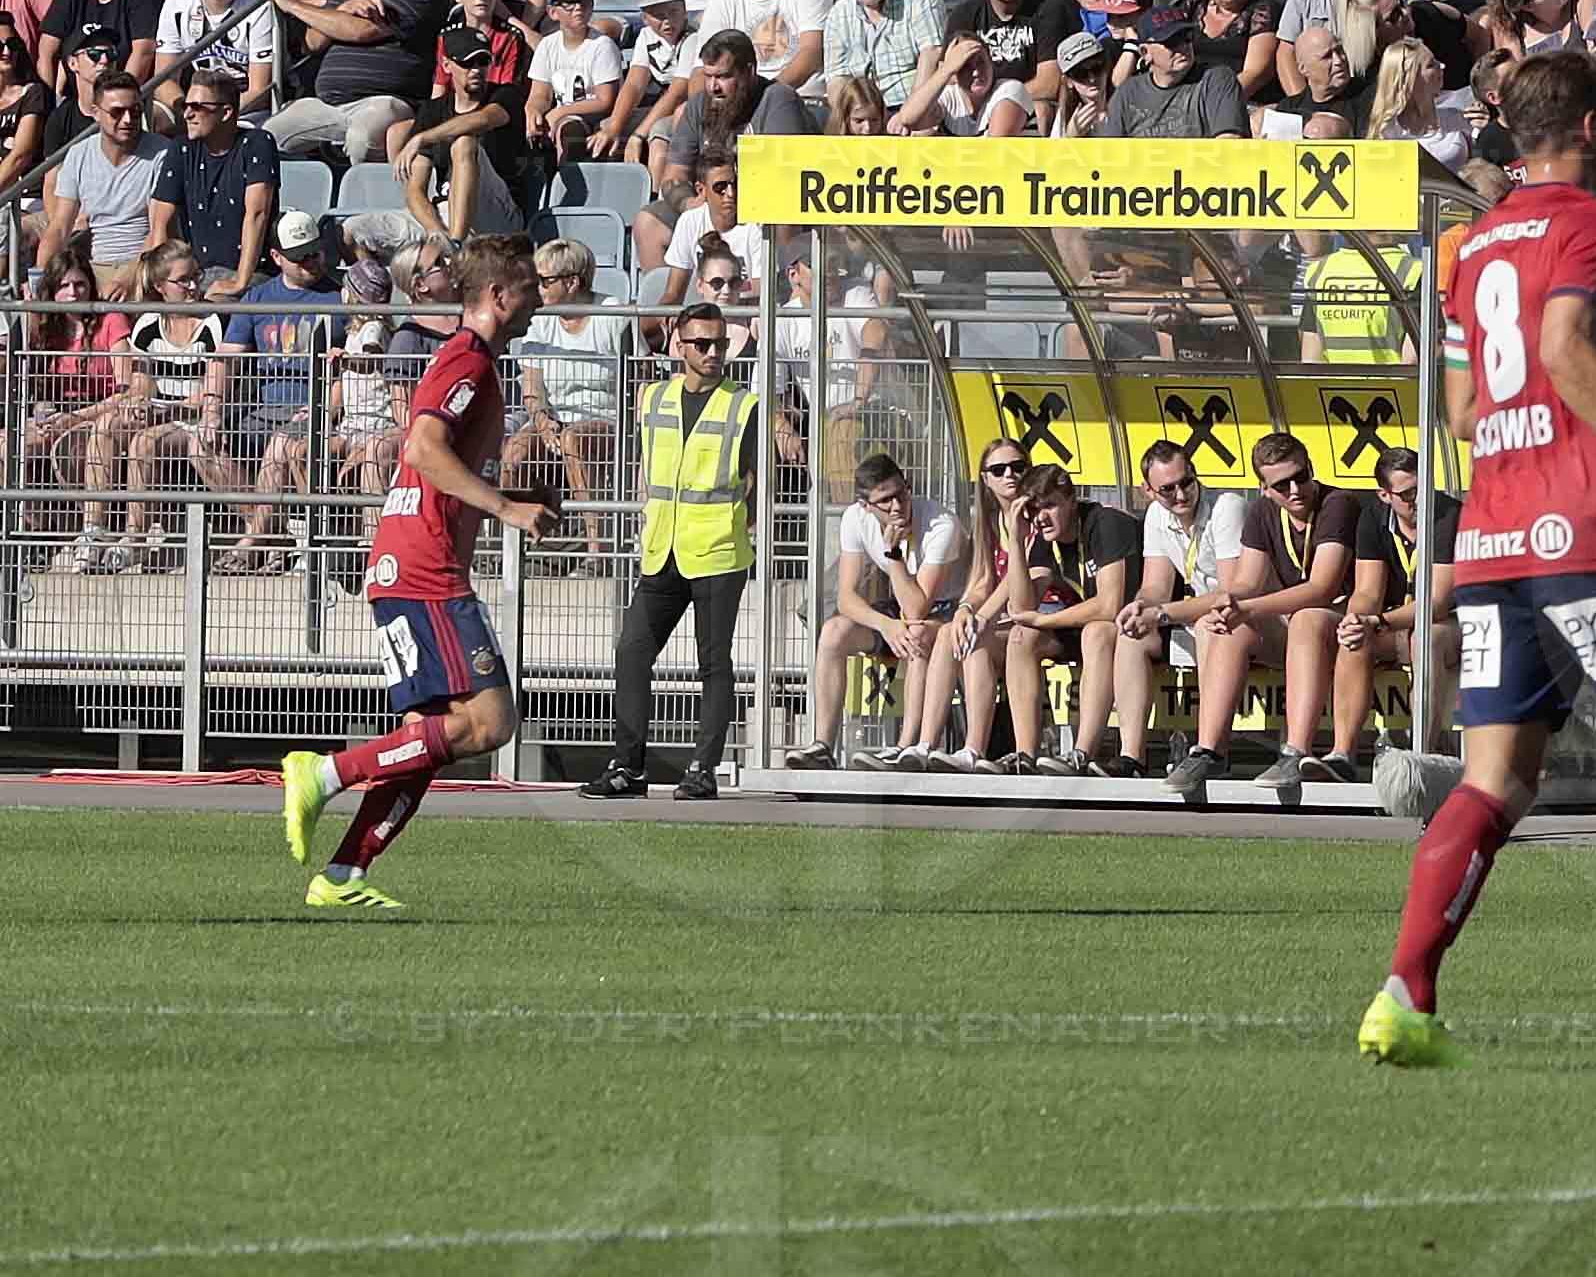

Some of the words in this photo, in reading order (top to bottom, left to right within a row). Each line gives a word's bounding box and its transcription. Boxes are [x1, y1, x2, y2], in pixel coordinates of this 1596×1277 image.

[802, 171, 1005, 216] Raiffeisen
[1023, 168, 1287, 219] Trainerbank
[1322, 308, 1377, 322] SECURITY
[1474, 258, 1527, 404] 8
